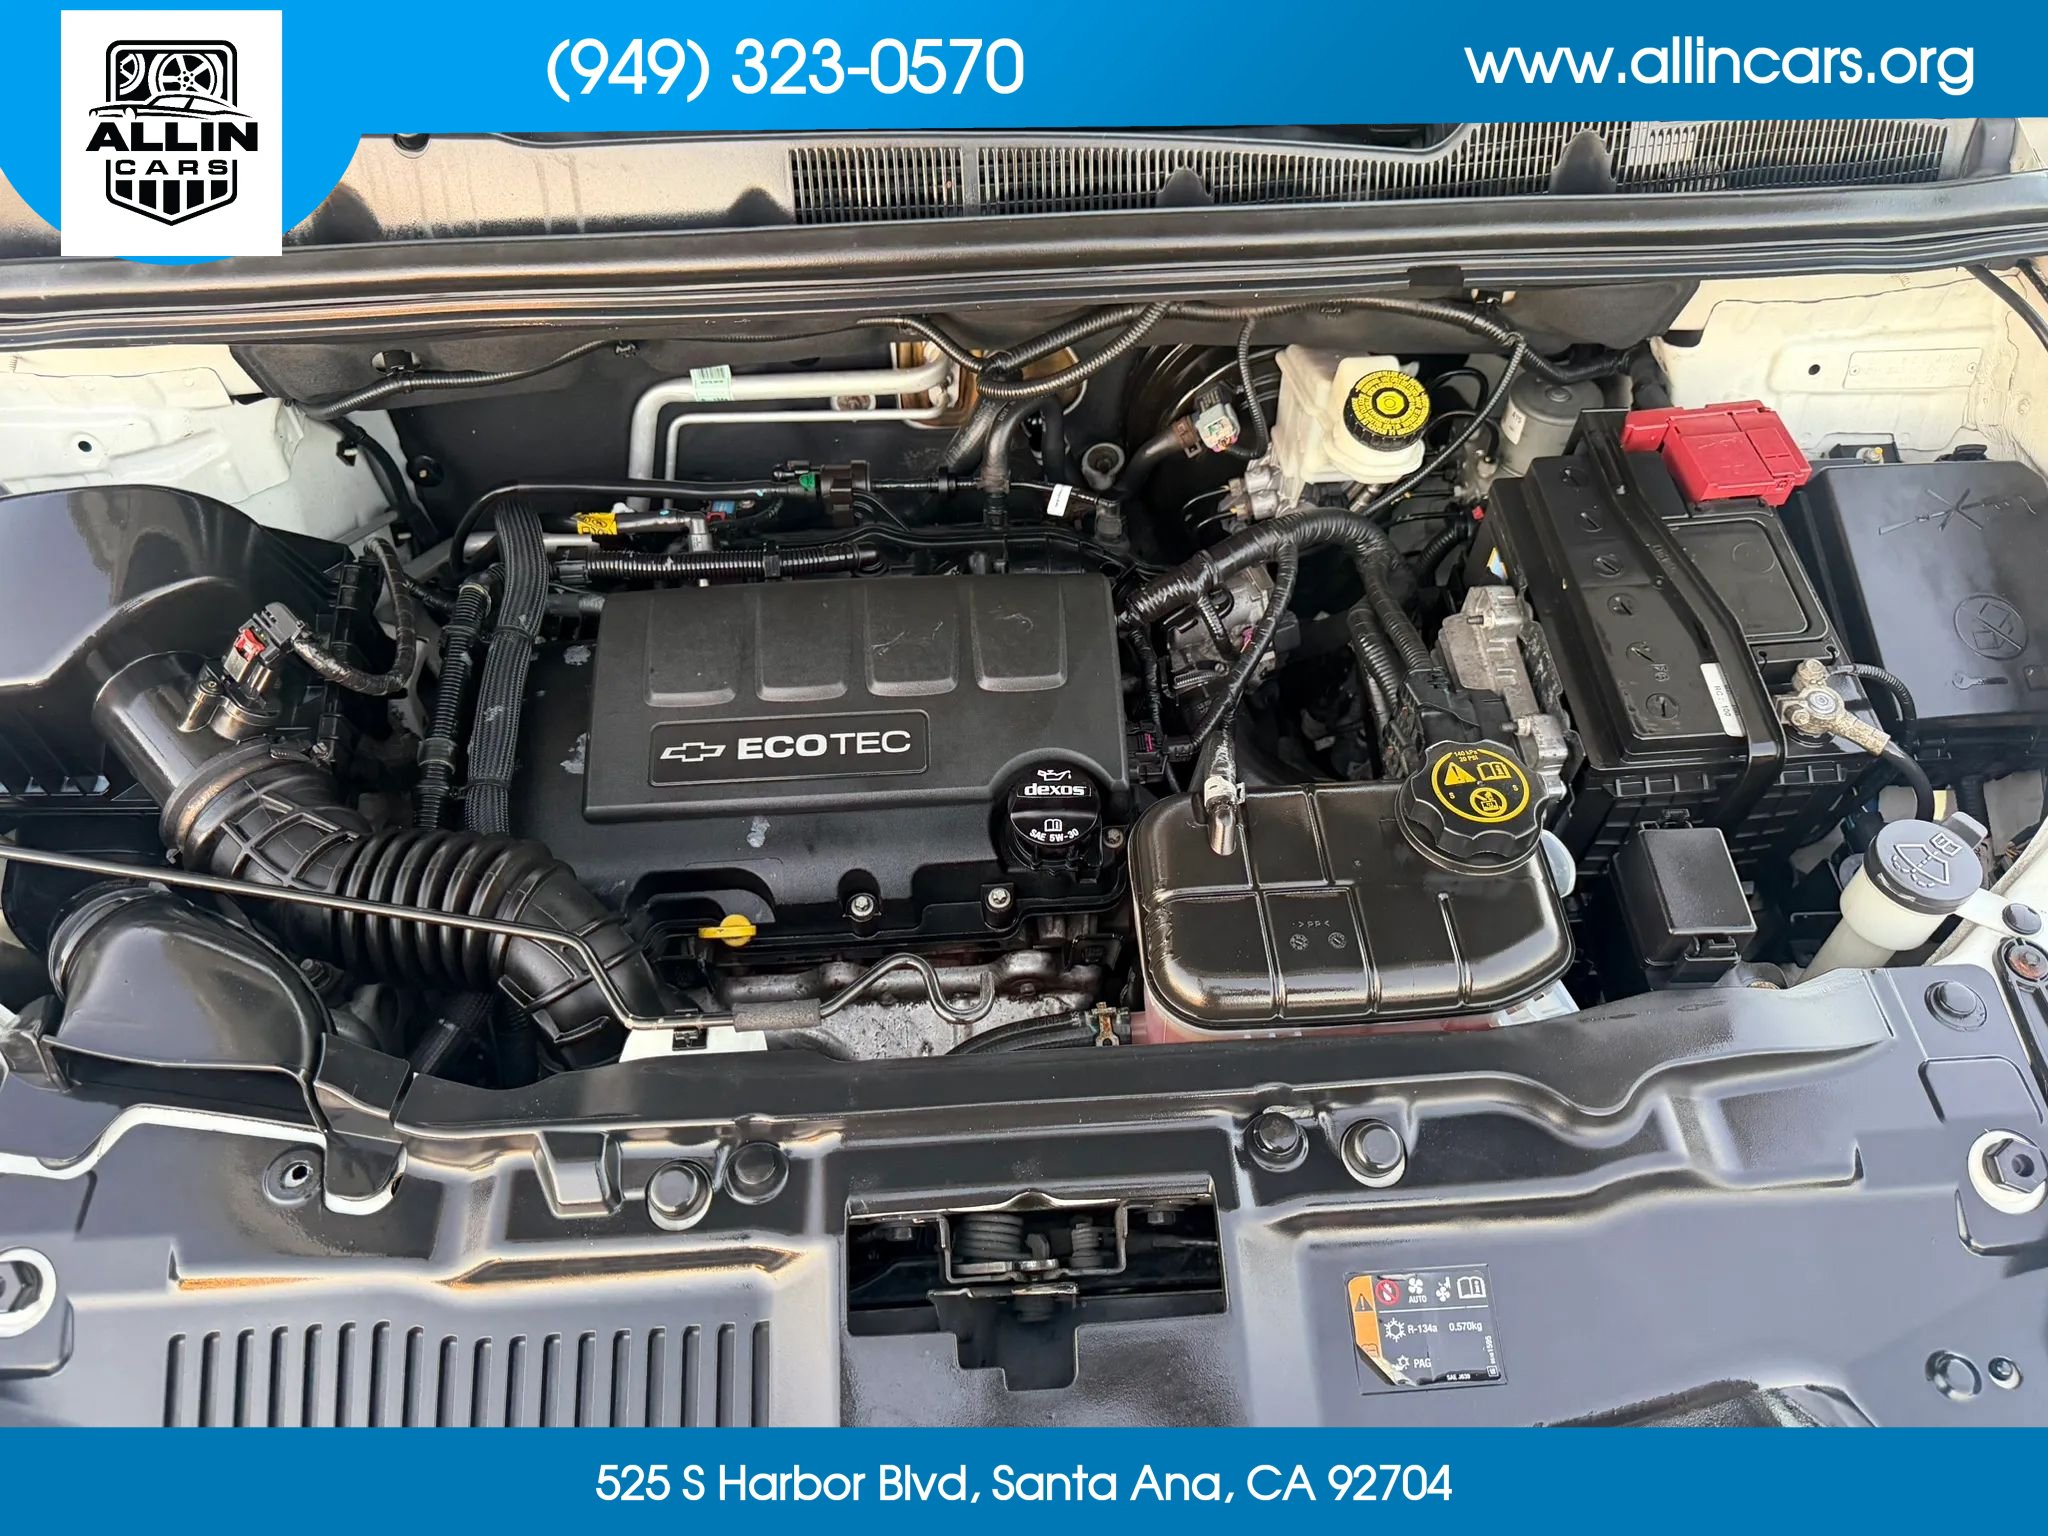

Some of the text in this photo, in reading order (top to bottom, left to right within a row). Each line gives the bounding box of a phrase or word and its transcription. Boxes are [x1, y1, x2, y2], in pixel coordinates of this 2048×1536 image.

[736, 729, 912, 760] ECOTEC
[1023, 783, 1087, 796] dexos
[1029, 828, 1080, 842] SAE 5W-30
[1408, 1295, 1428, 1304] AUTO
[1407, 1321, 1483, 1334] R-134a 0.570kg
[1413, 1359, 1432, 1369] PAG
